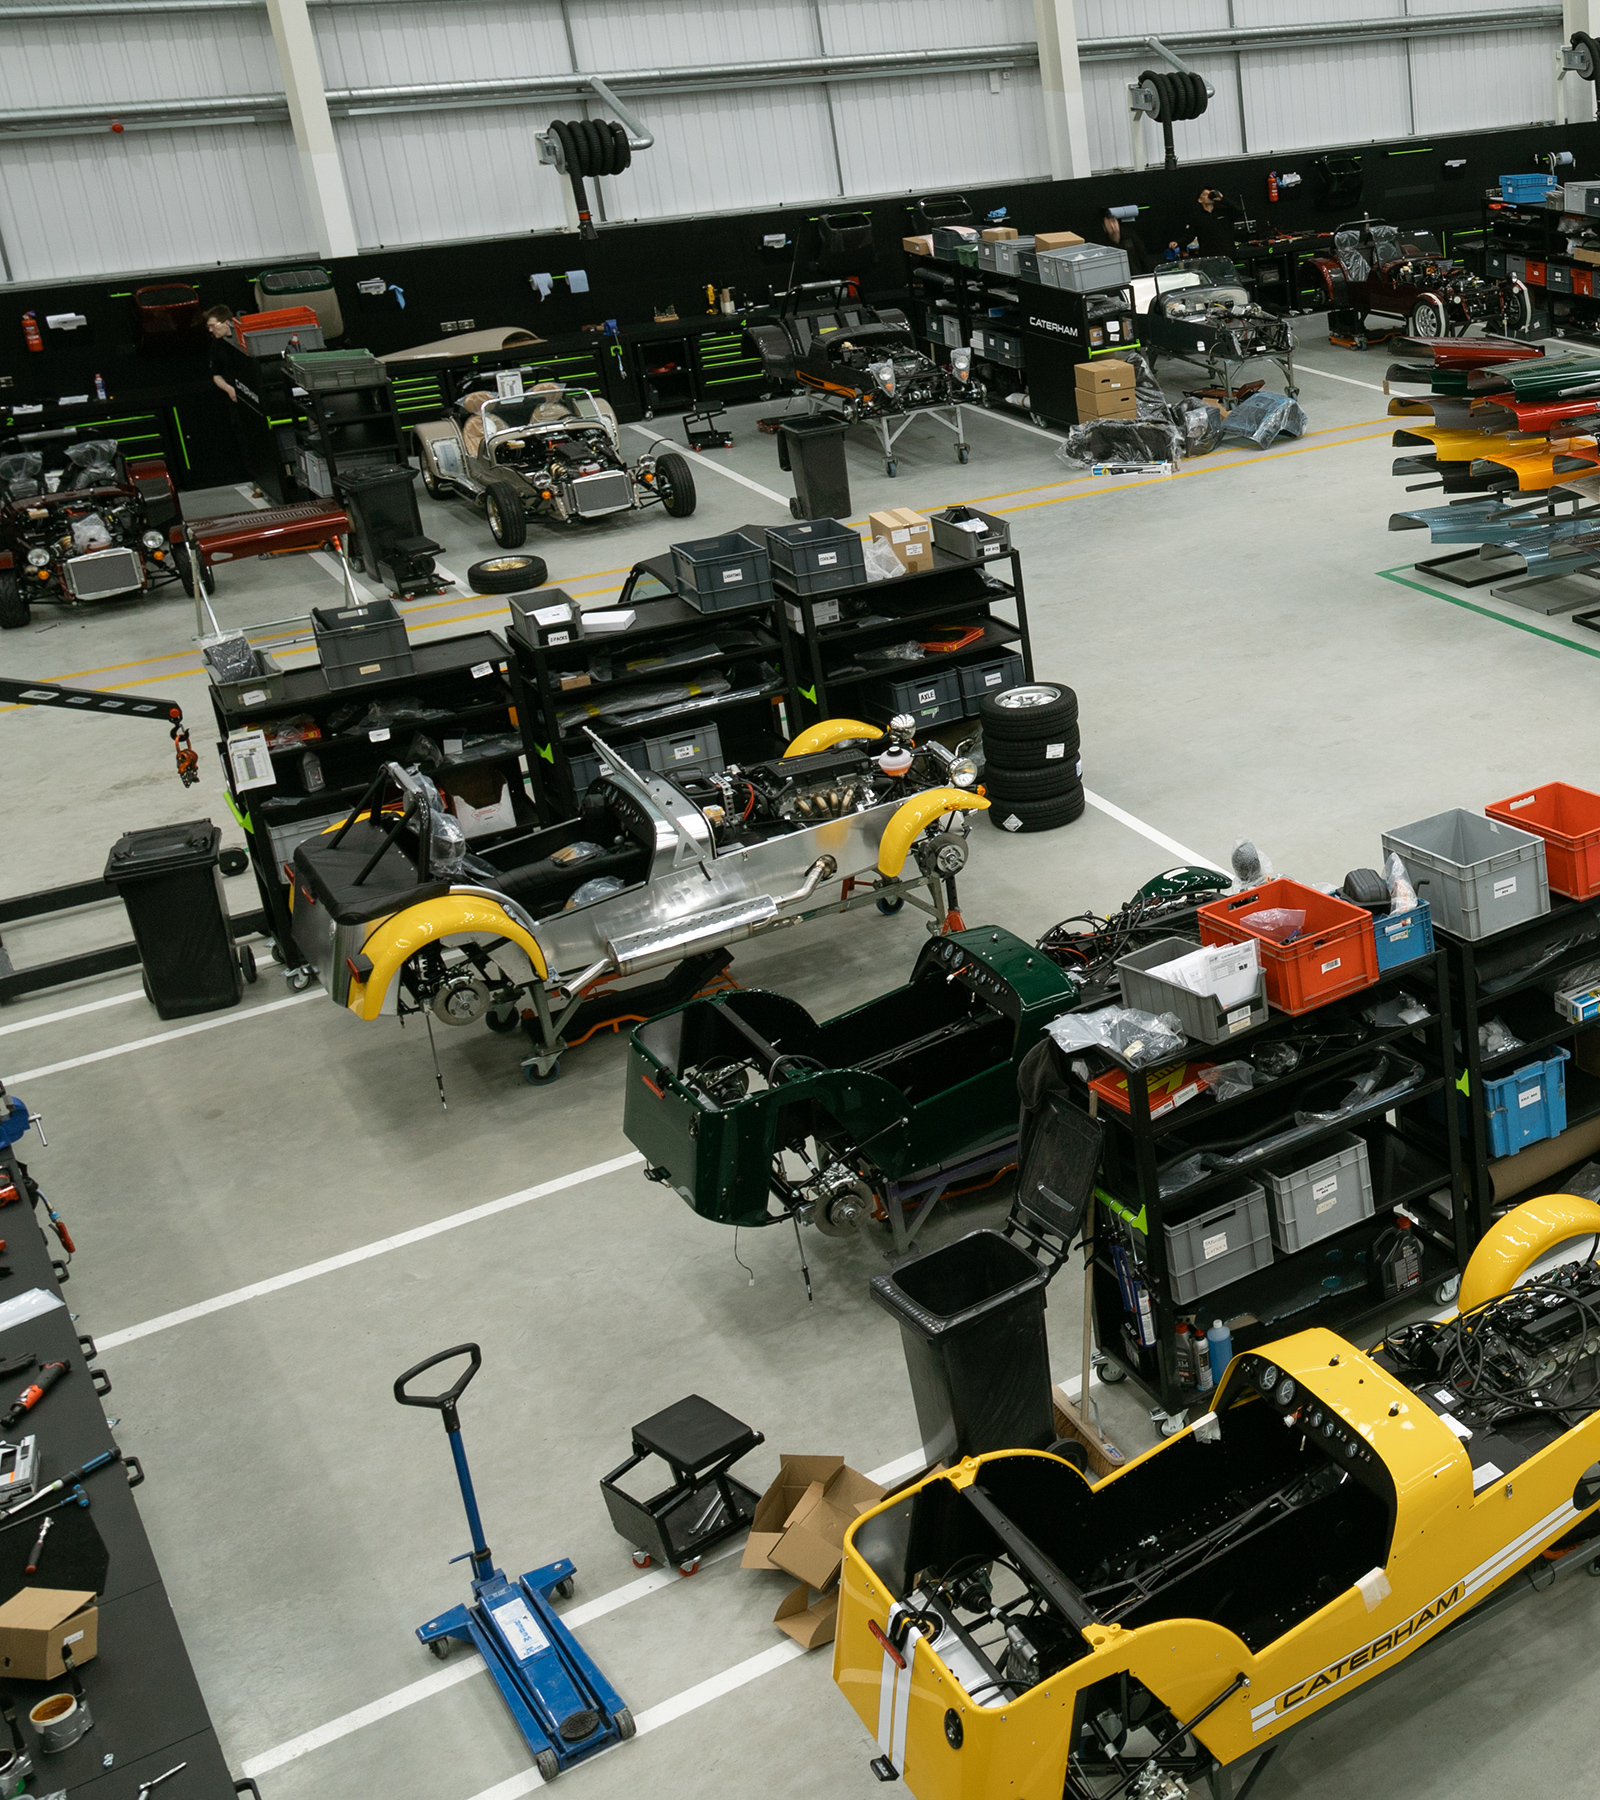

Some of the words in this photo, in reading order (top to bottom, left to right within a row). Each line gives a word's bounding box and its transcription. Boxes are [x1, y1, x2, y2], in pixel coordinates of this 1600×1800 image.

[740, 319, 747, 327] 4
[1029, 316, 1078, 337] CATERHAM
[472, 355, 479, 364] 3
[6, 417, 14, 426] 2
[920, 691, 935, 701] AXLE
[1282, 1587, 1460, 1711] CATERHAM
